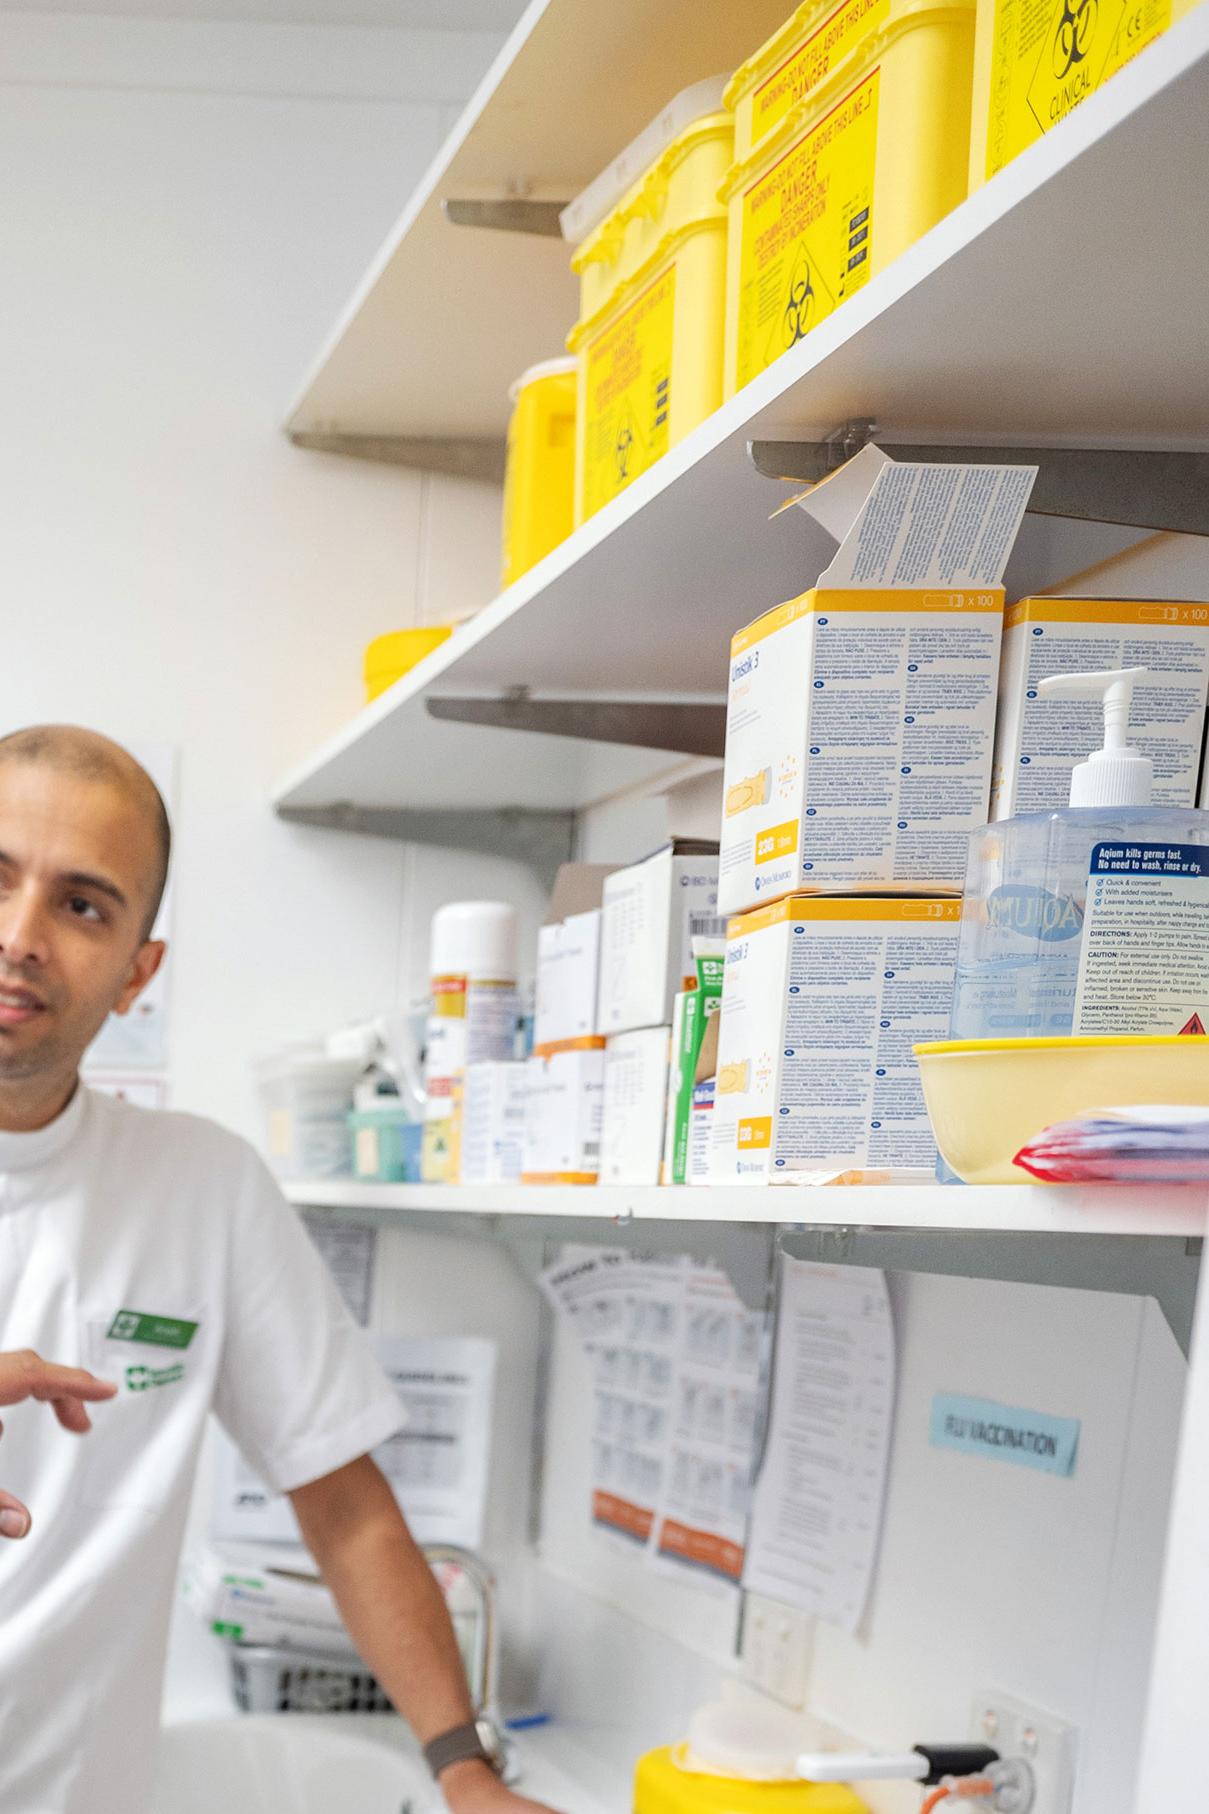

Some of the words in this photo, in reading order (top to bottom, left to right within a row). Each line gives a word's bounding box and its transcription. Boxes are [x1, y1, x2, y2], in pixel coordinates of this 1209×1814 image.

[1050, 66, 1090, 119] CLINICAL
[780, 157, 817, 215] DANGER
[977, 595, 993, 606] 100
[1192, 609, 1207, 620] 100
[1099, 848, 1123, 859] Aqium
[1126, 849, 1141, 858] kills
[1144, 851, 1165, 860] germs
[1167, 850, 1181, 859] fast.
[1098, 860, 1109, 869] No
[1111, 860, 1130, 869] need
[1132, 860, 1139, 869] to
[1142, 861, 1161, 870] wash,
[1164, 861, 1180, 870] rinse
[1190, 862, 1201, 874] dry.
[971, 1420, 1057, 1457] VACCINATION
